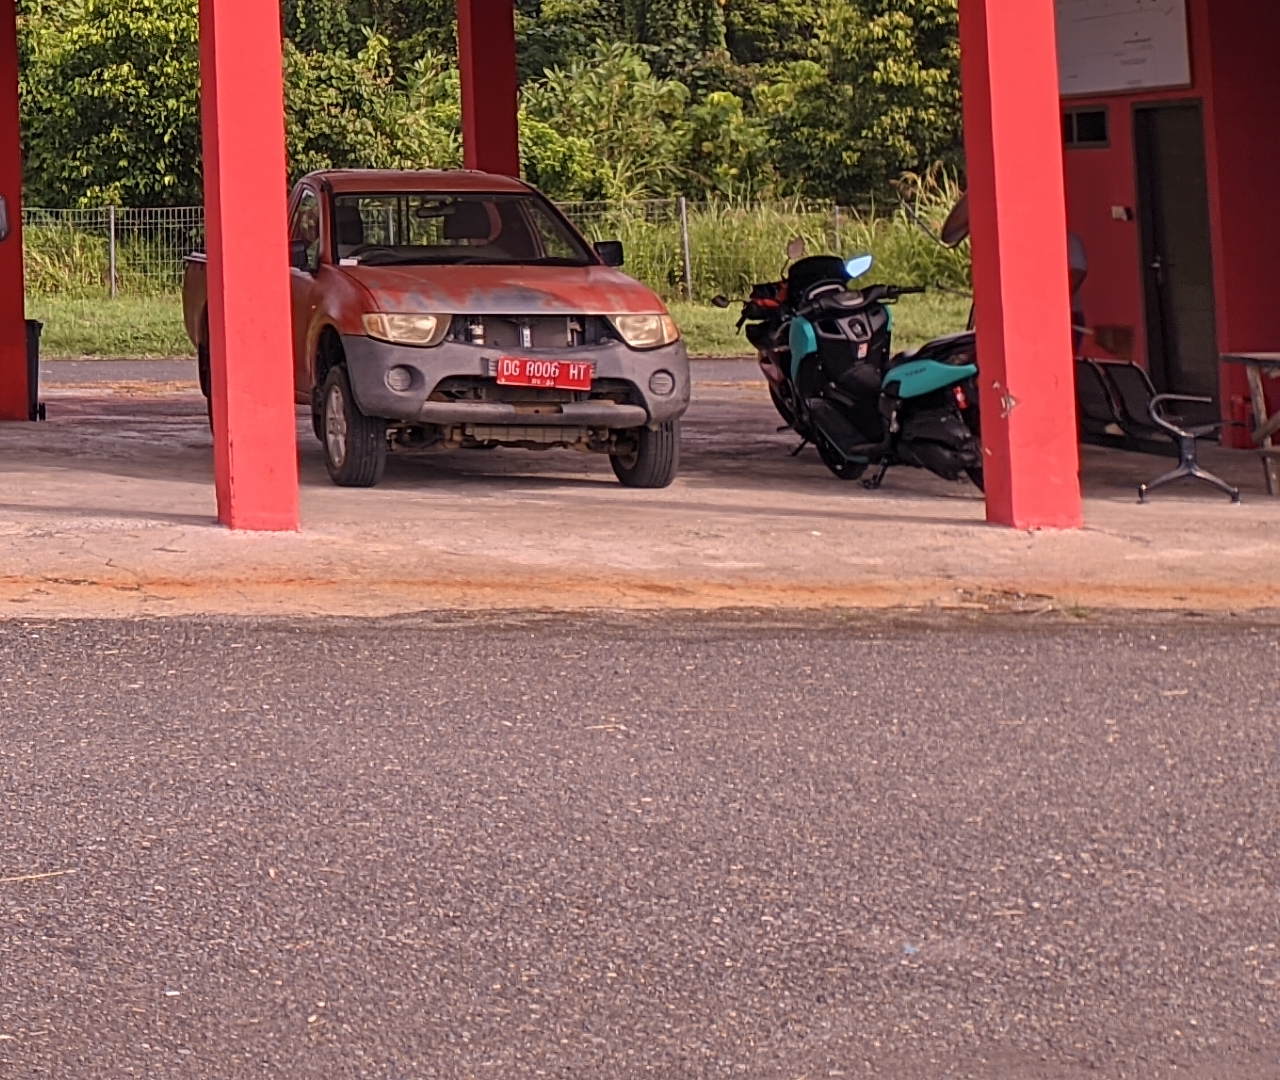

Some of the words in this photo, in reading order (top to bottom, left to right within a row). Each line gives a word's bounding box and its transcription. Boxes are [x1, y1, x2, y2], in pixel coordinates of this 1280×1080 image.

[503, 360, 520, 376] DG
[526, 361, 559, 378] 8006
[569, 363, 587, 380] HT
